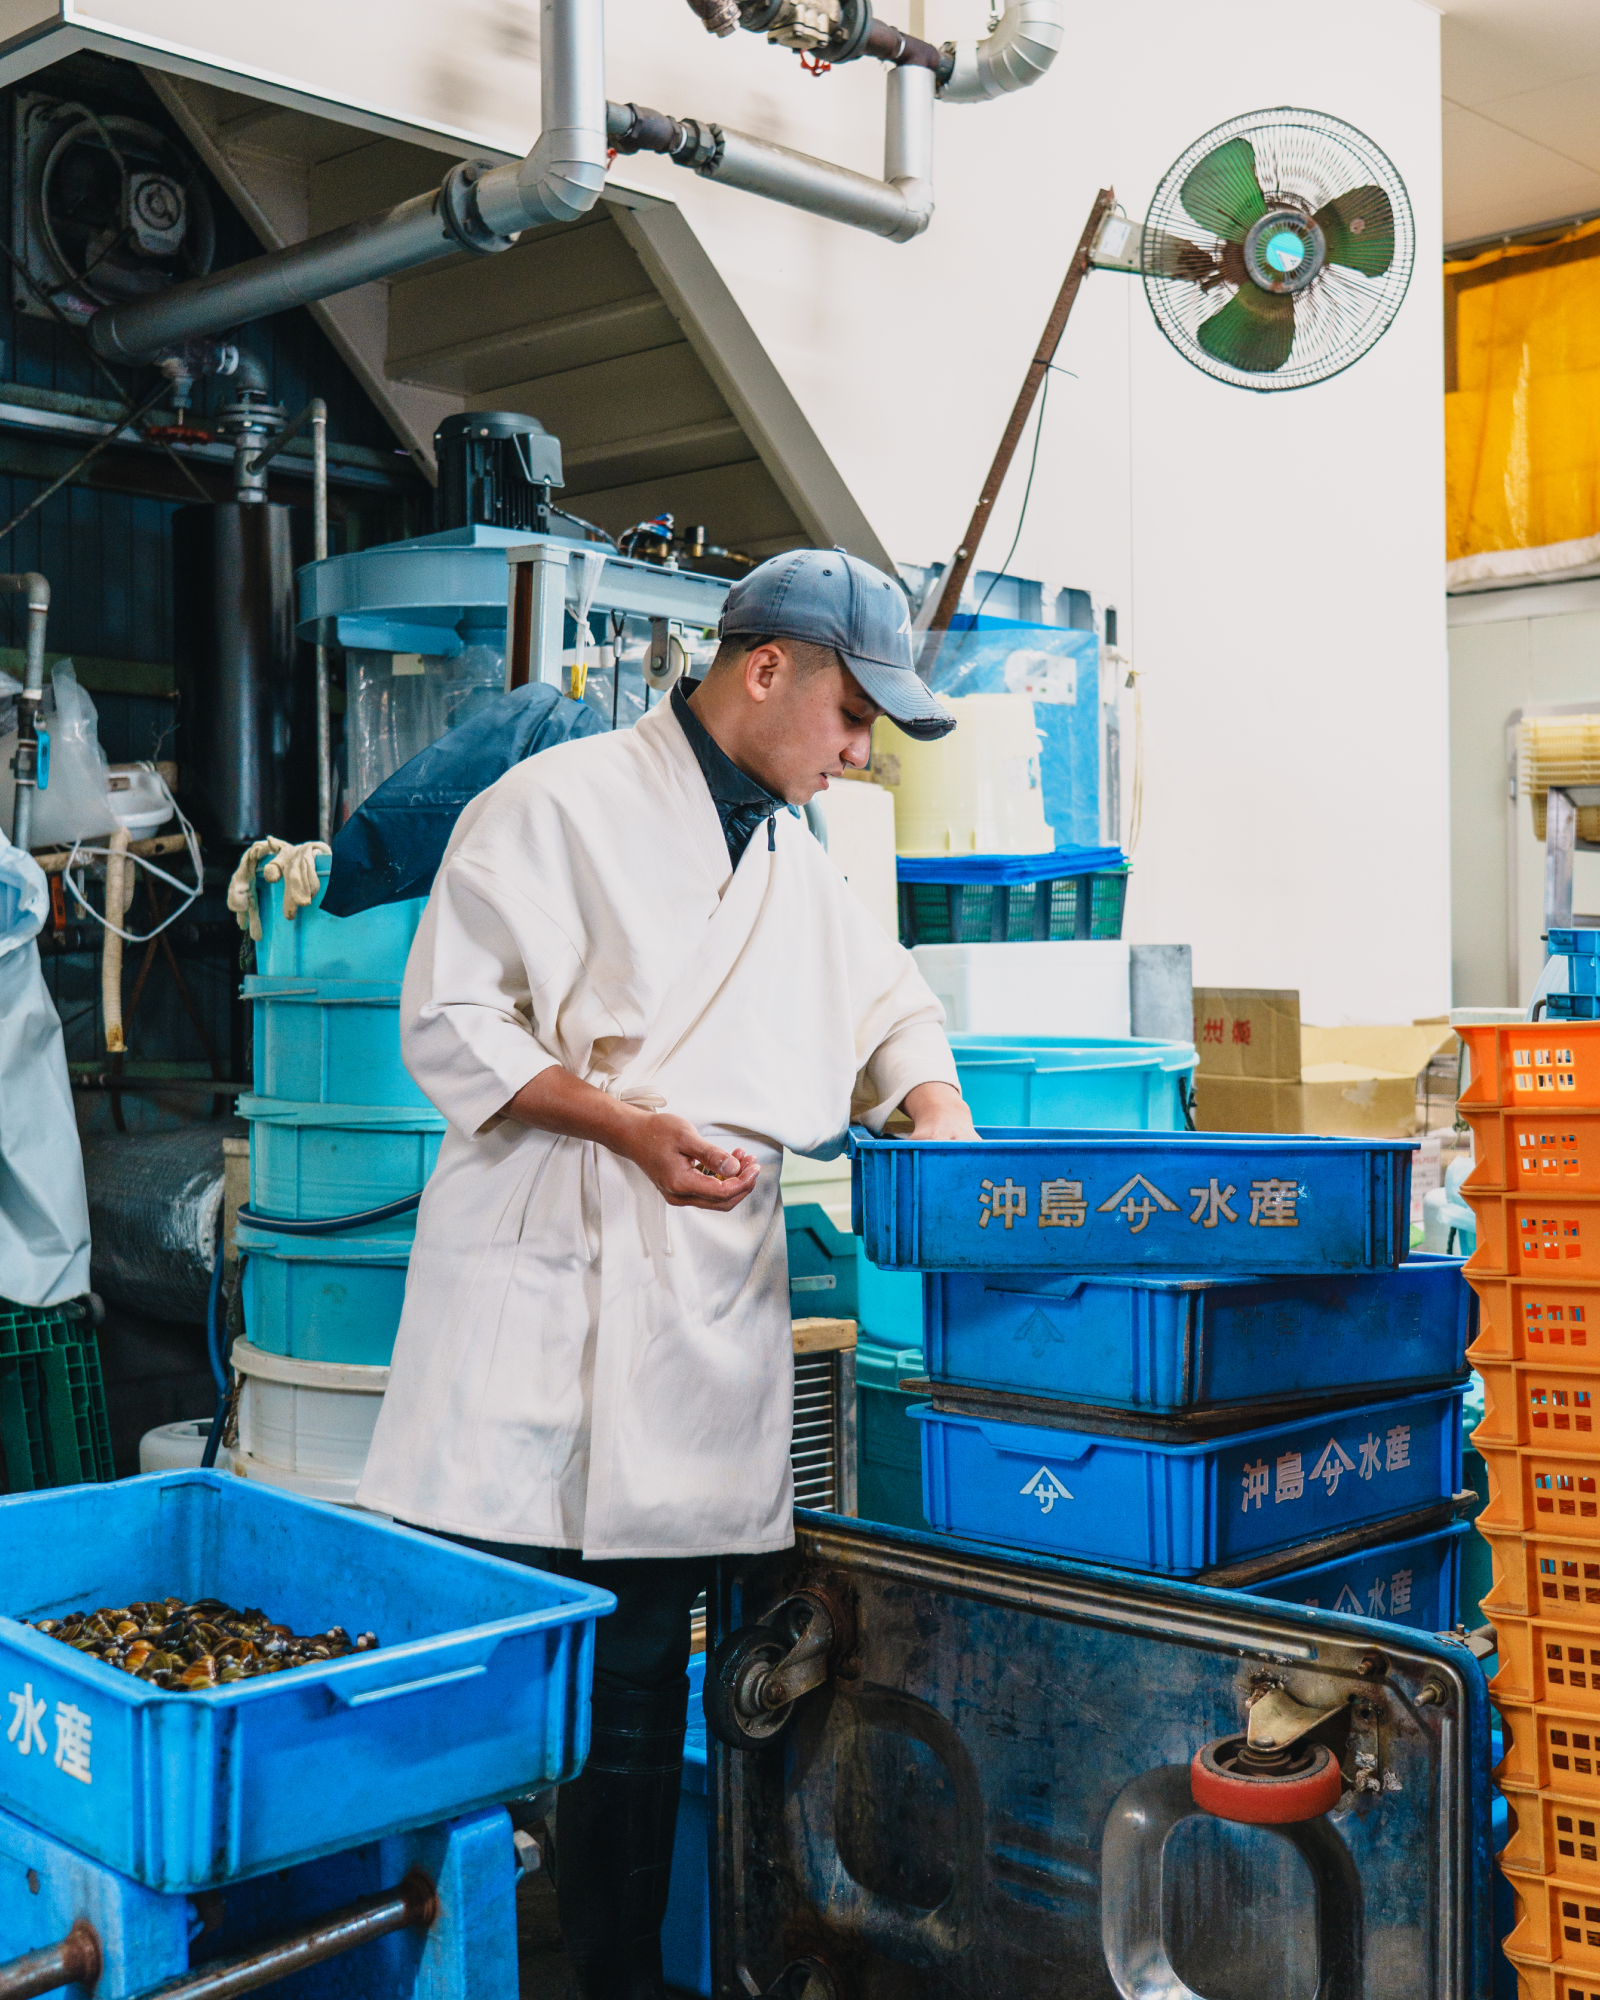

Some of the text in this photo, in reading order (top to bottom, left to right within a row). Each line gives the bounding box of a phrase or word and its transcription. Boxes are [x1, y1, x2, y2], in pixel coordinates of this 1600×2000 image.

[979, 1177, 1088, 1229] 沖島
[1189, 1178, 1299, 1229] 水産
[1241, 1451, 1305, 1513] 沖島
[1358, 1424, 1411, 1481] 水産
[1367, 1568, 1413, 1619] 水産
[7, 1682, 92, 1785] 水産
